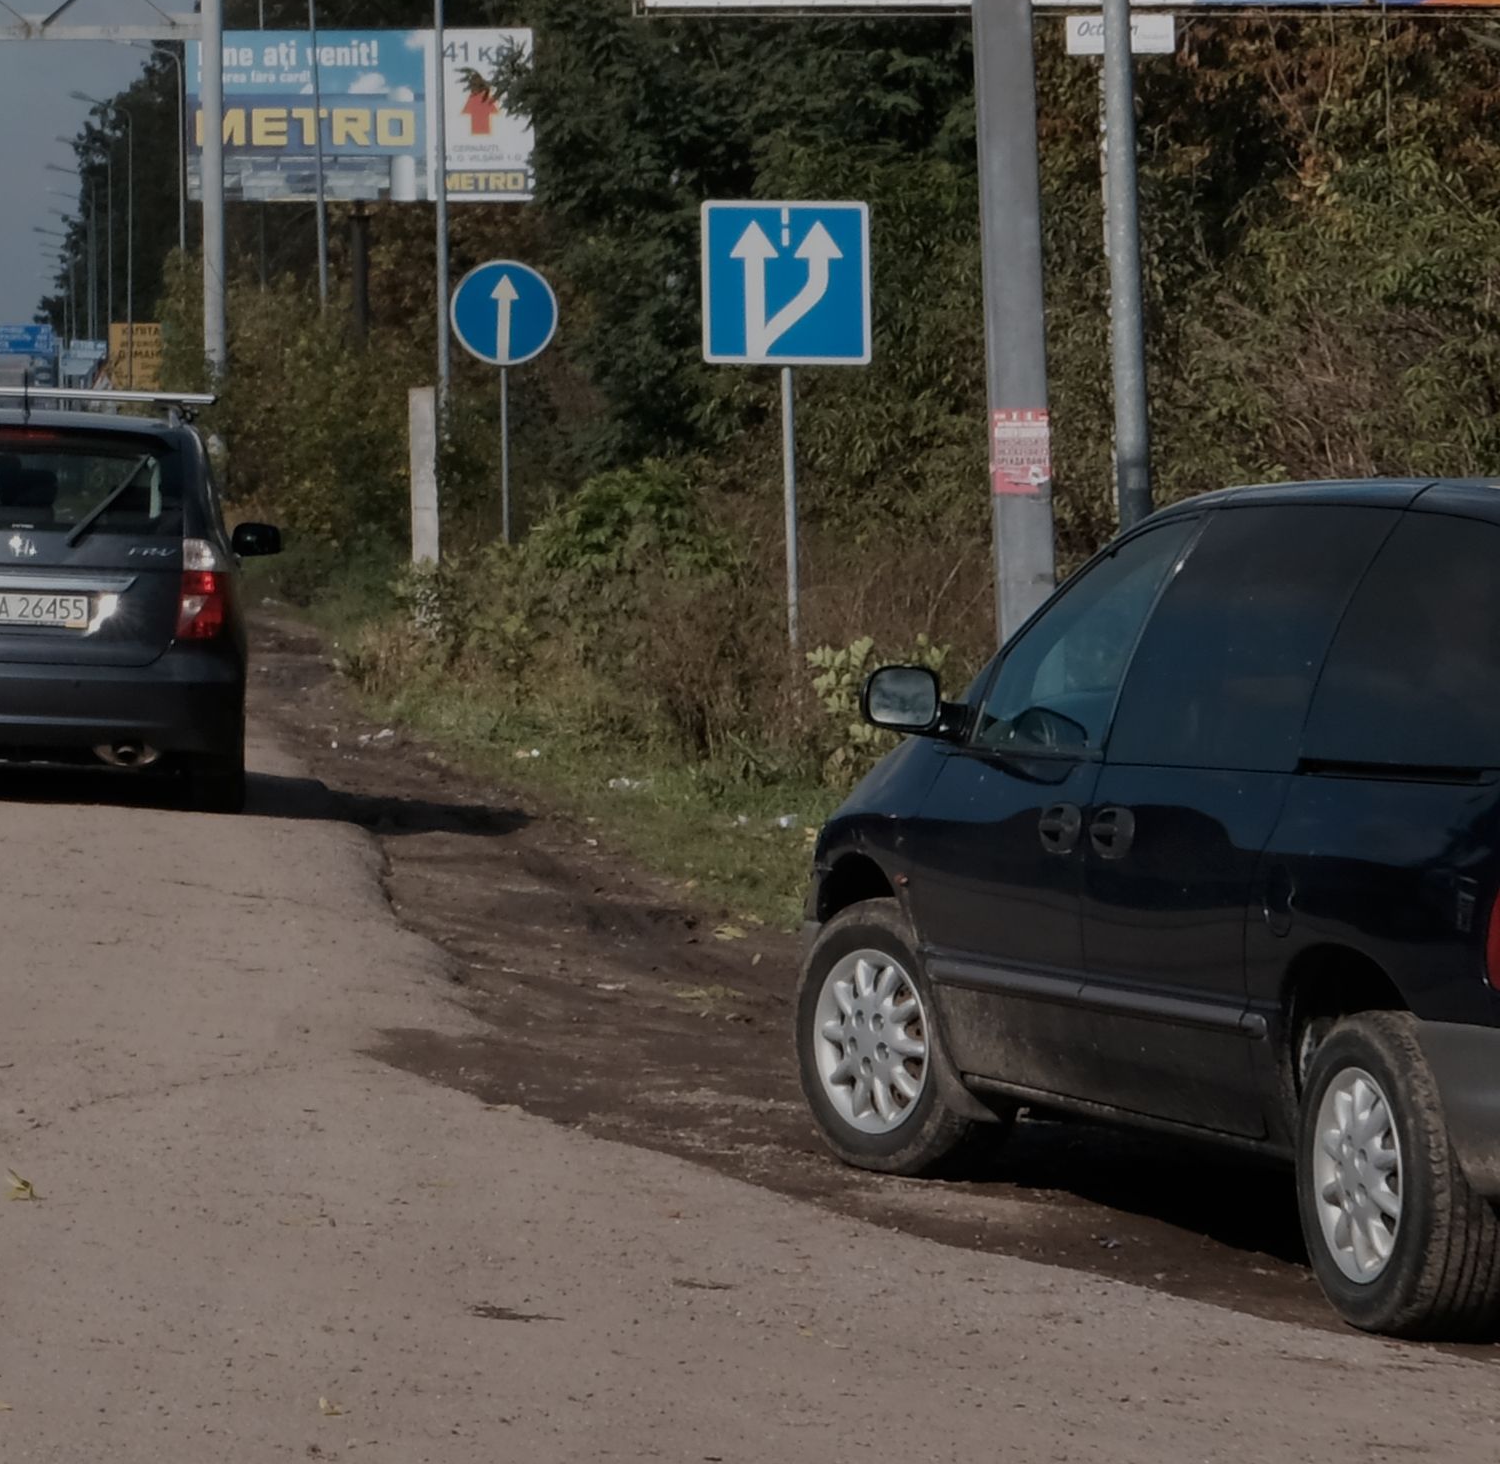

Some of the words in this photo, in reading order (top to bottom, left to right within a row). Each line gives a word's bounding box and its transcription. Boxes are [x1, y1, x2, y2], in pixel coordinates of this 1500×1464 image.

[195, 107, 415, 147] METRO
[445, 171, 526, 192] METRO
[17, 598, 85, 620] 26455
